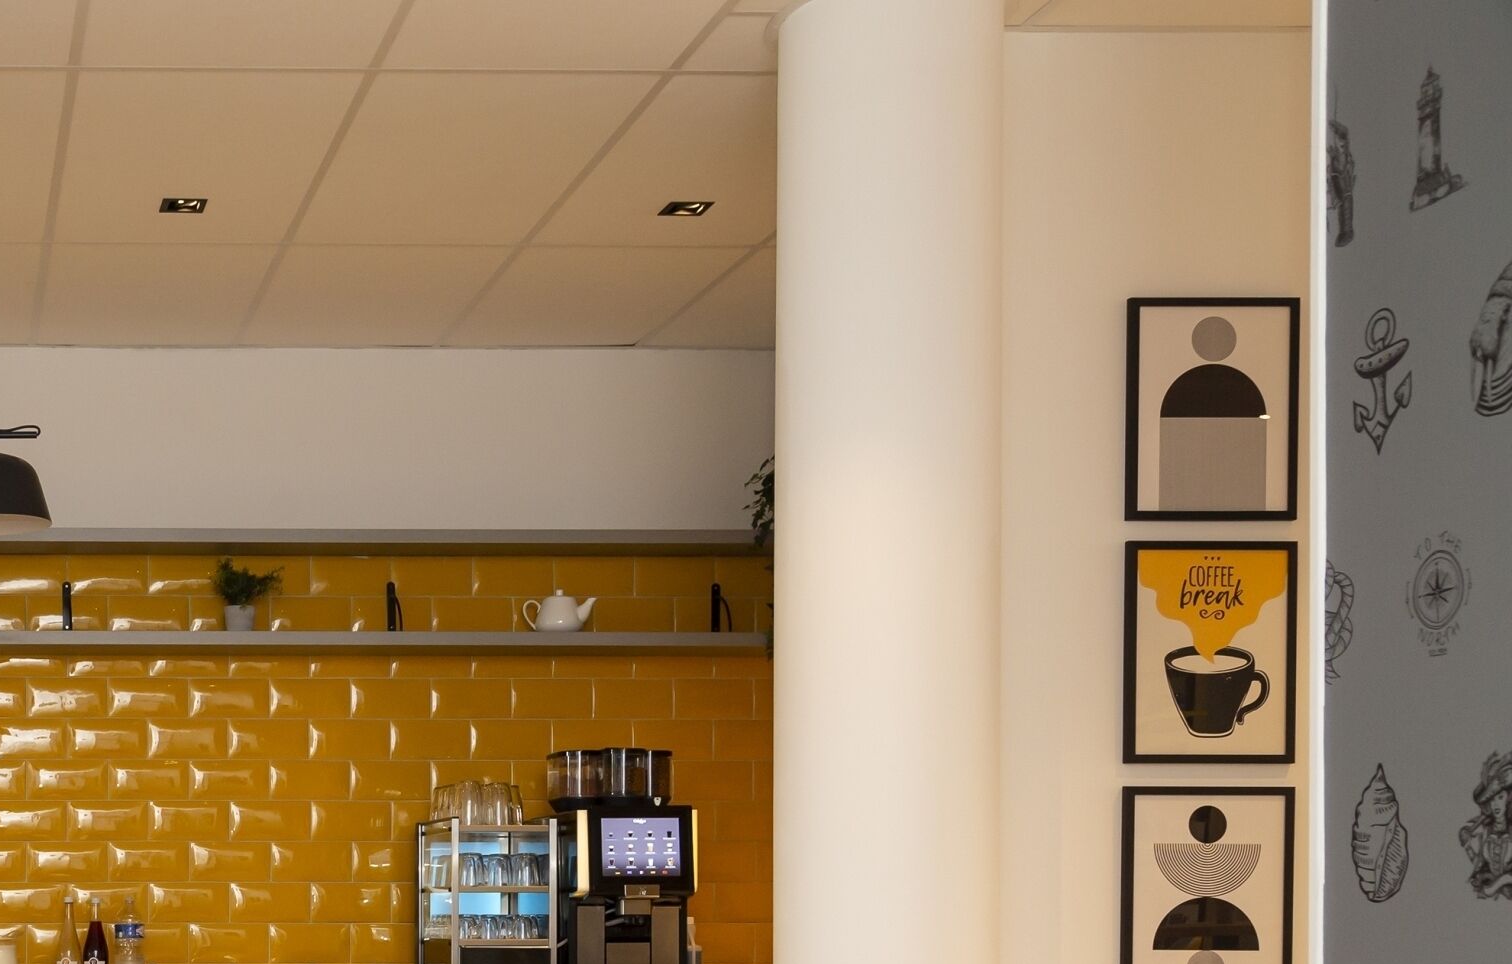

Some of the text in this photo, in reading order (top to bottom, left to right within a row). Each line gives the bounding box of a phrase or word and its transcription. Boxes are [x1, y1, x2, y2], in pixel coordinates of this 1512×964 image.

[1438, 530, 1462, 554] THE
[1188, 565, 1236, 588] COFFEE
[1179, 579, 1244, 610] break
[1418, 621, 1460, 648] NORTH
